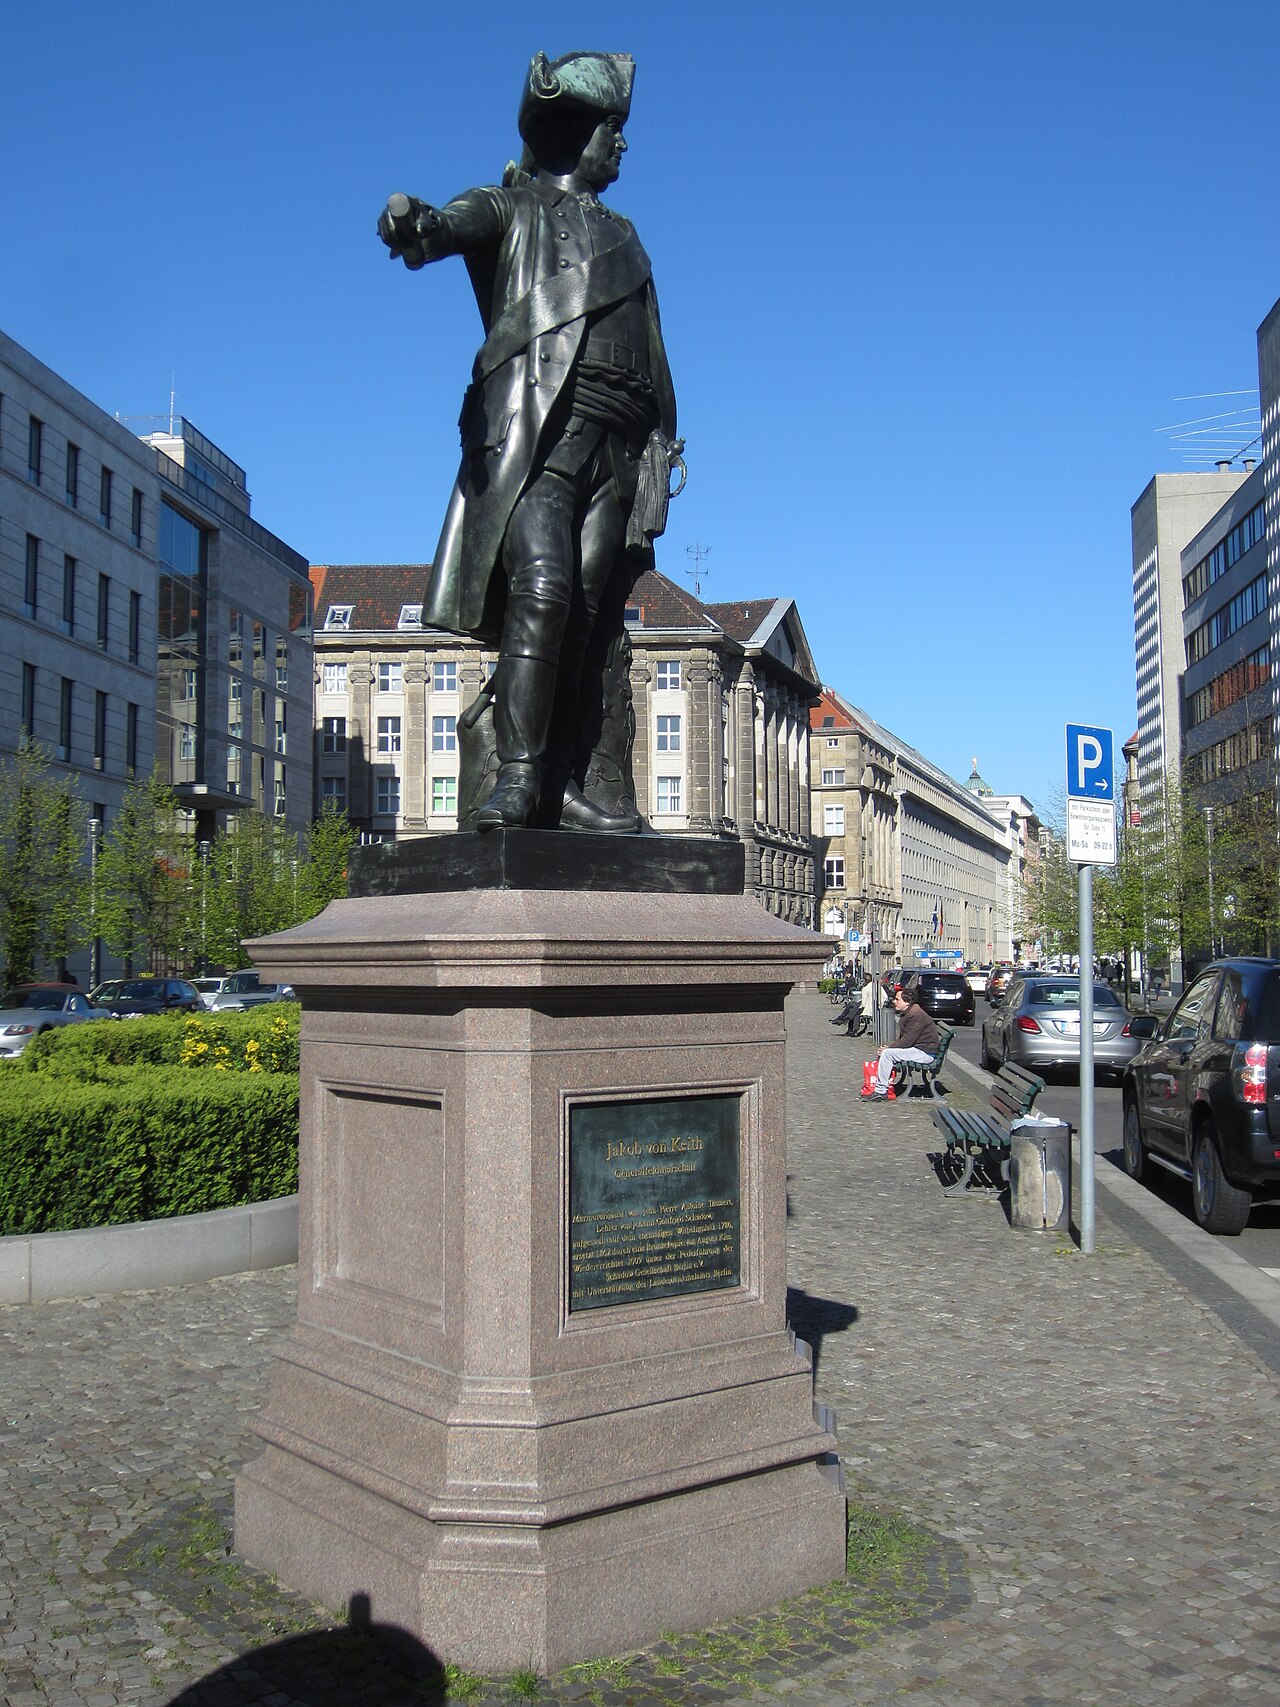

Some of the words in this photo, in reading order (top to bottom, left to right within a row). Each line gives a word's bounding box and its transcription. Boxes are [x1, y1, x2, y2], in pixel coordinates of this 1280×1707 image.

[1077, 734, 1103, 788] P
[1080, 804, 1101, 813] Parkschein
[1071, 839, 1088, 849] Mo-Sa
[606, 1140, 643, 1161] Jakob
[647, 1142, 667, 1155] von
[671, 1136, 704, 1154] Keith
[614, 1161, 697, 1180] Generalfeldmarschall
[572, 1210, 625, 1224] Marmororiginal
[596, 1224, 618, 1233] Lehrer
[608, 1234, 621, 1244] auf
[622, 1233, 636, 1241] dem
[572, 1251, 594, 1261] ersetzt
[612, 1246, 631, 1256] durch
[632, 1245, 645, 1253] eine
[646, 1255, 662, 1263] unter
[723, 1244, 734, 1252] der
[674, 1261, 692, 1272] Berlin
[572, 1288, 584, 1298] mit
[636, 1280, 646, 1289] des
